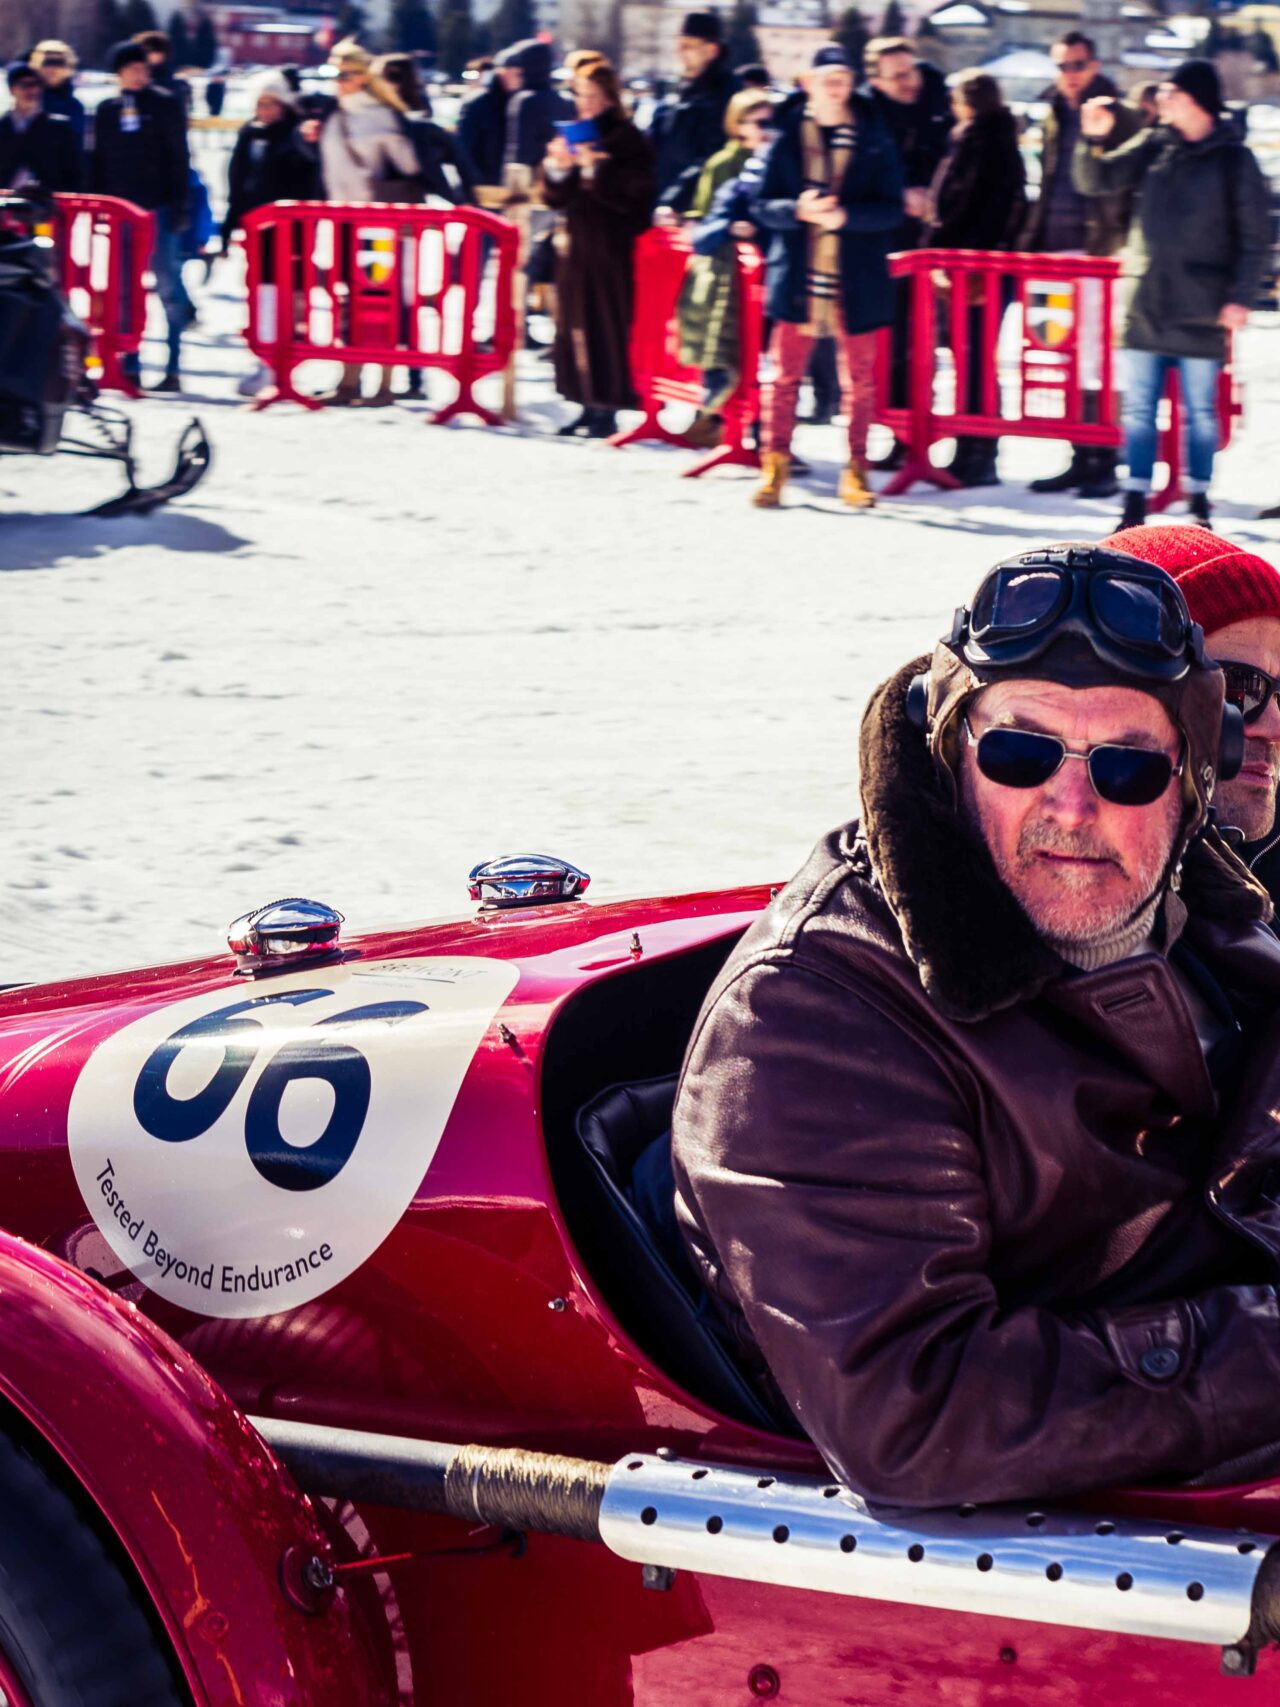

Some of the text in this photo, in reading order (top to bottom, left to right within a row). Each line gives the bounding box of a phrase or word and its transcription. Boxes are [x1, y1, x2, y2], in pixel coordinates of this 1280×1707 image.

[133, 988, 430, 1192] 66
[96, 1158, 333, 1293] Tested Beyond Endurance
